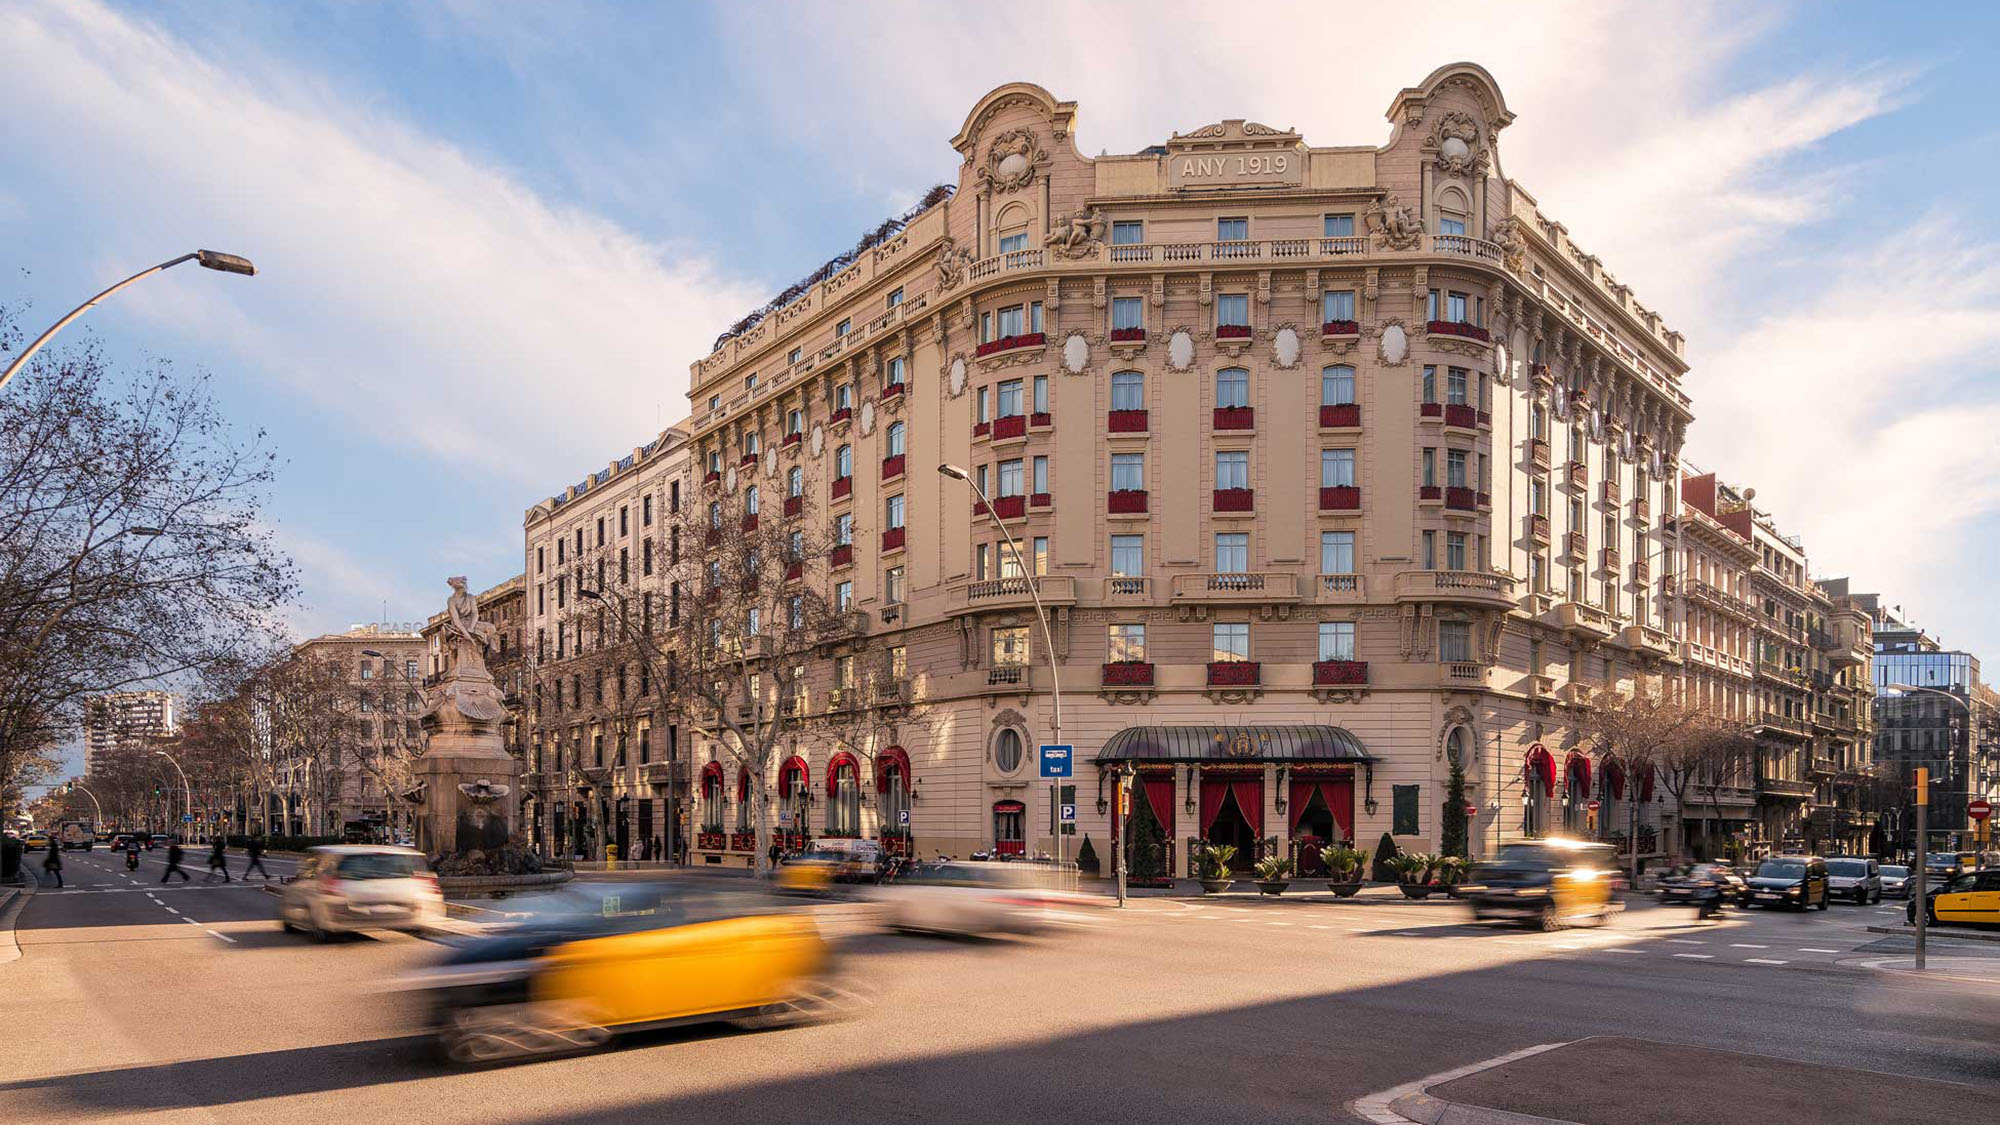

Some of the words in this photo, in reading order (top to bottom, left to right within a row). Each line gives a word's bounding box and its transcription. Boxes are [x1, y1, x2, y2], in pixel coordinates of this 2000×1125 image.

[1182, 158, 1227, 177] ANY
[1237, 155, 1288, 175] 1919
[900, 811, 908, 822] P
[1063, 806, 1073, 819] P
